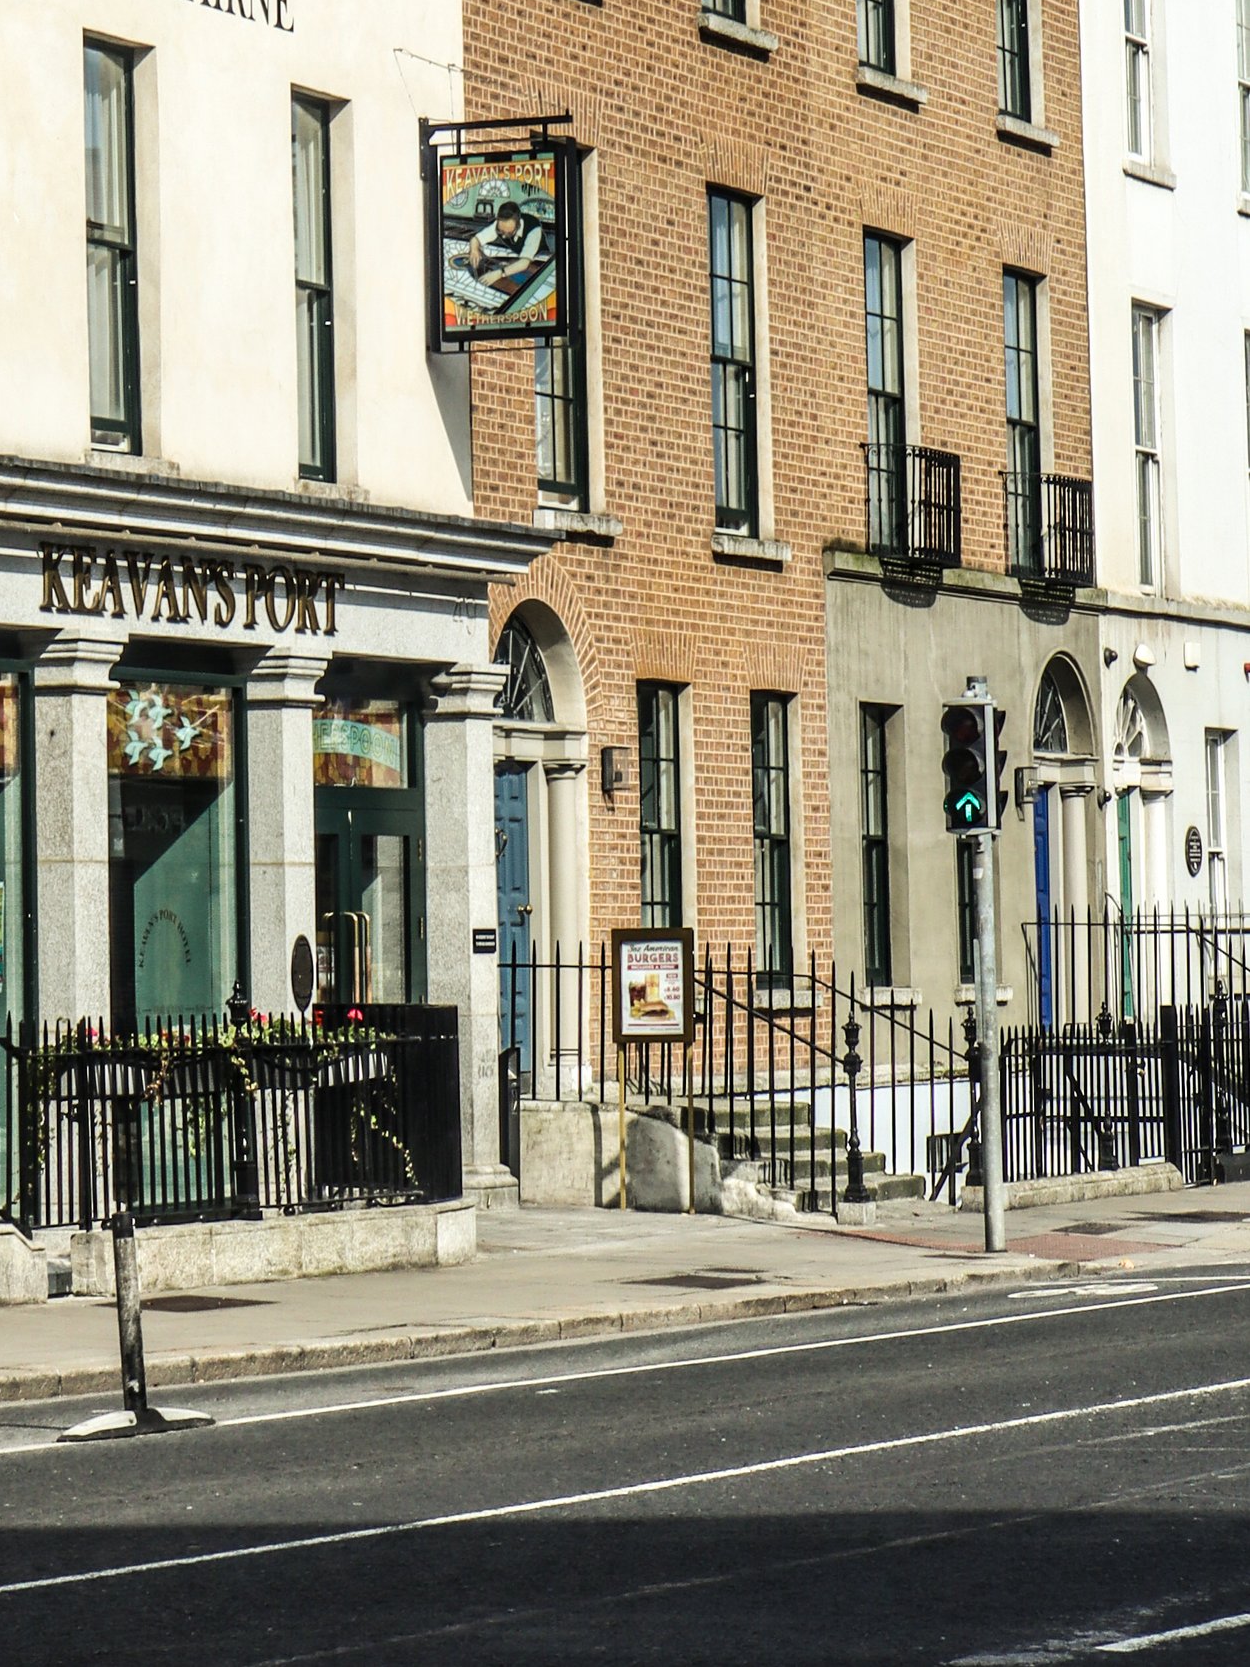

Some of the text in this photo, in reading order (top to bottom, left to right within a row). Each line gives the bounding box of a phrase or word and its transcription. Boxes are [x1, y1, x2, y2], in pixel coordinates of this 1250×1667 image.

[446, 162, 551, 202] KEAVAN'S PORT
[455, 299, 548, 326] WETHERSPOON
[39, 541, 346, 636] KEAVAN'S PORT
[627, 953, 679, 963] BURGERS
